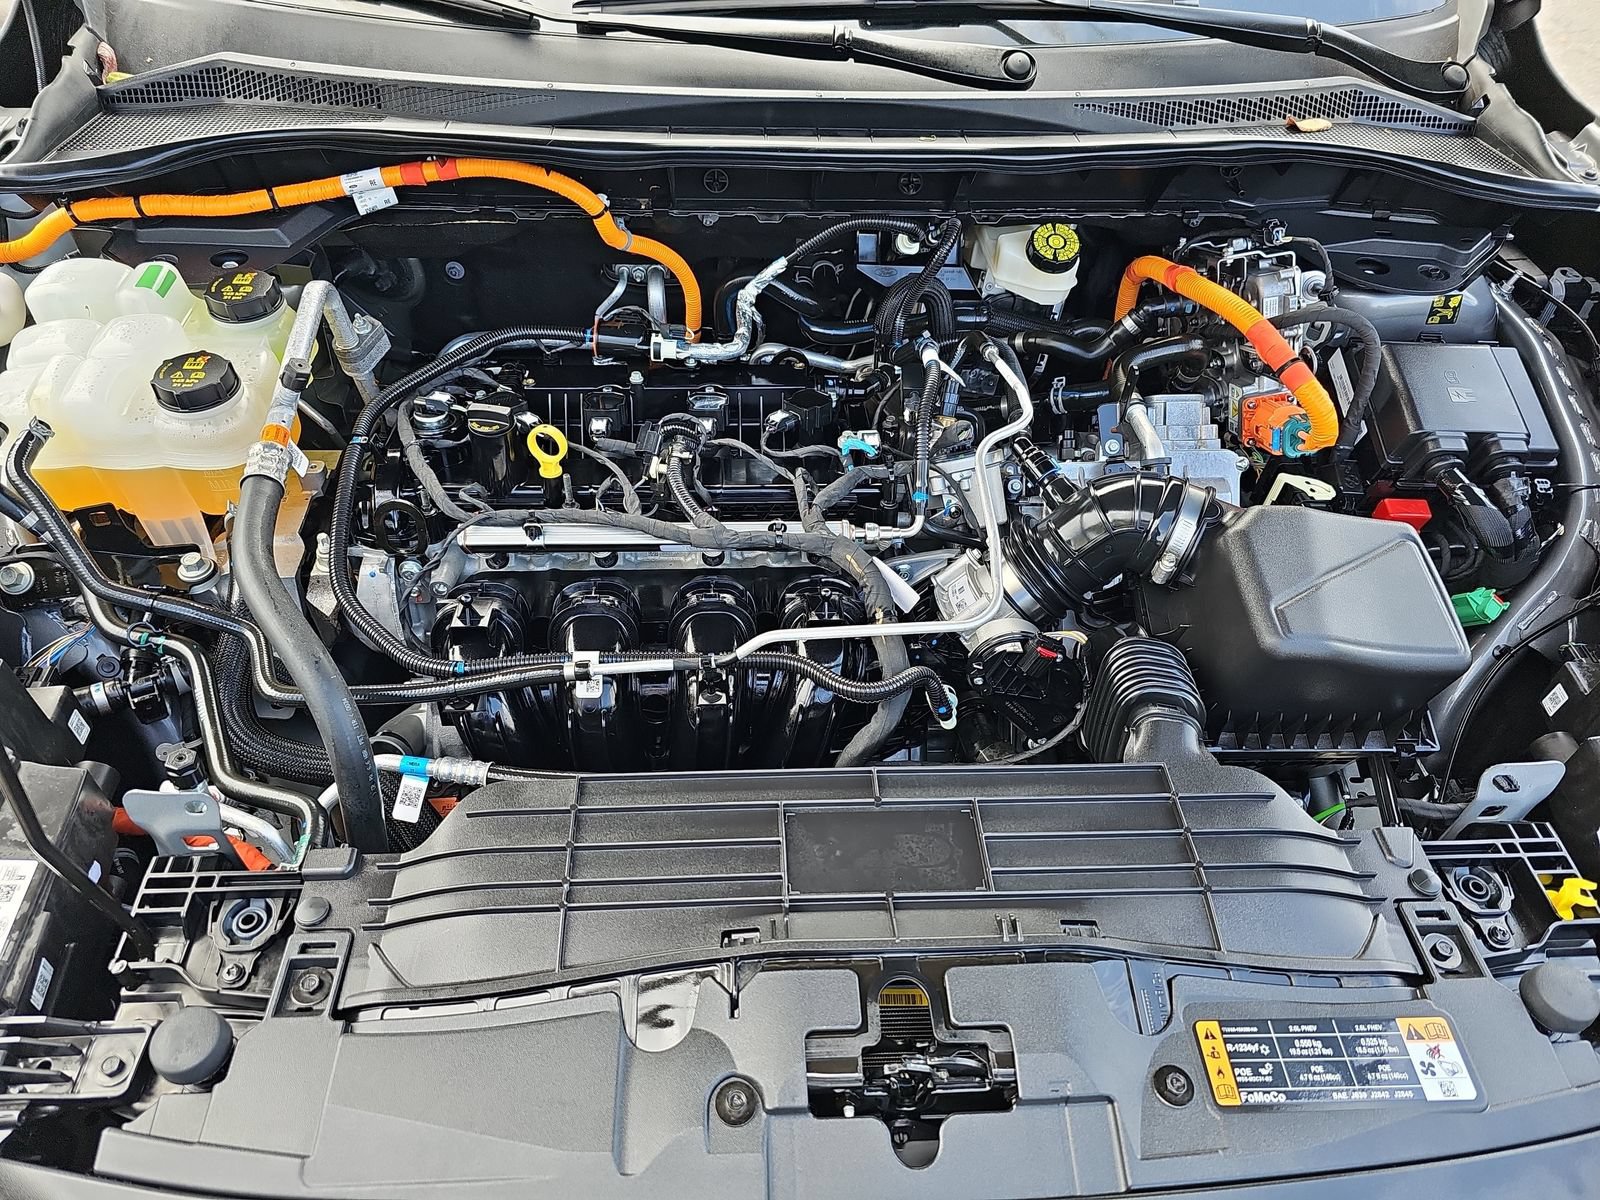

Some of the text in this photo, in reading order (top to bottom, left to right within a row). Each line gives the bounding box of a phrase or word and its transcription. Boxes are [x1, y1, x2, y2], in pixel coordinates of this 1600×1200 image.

[1312, 1039, 1322, 1049] kg
[1378, 1038, 1388, 1047] kg
[1234, 1067, 1253, 1076] POE
[1310, 1065, 1325, 1073] POE
[1378, 1064, 1392, 1072] POE
[1240, 1091, 1287, 1103] FoMoCo
